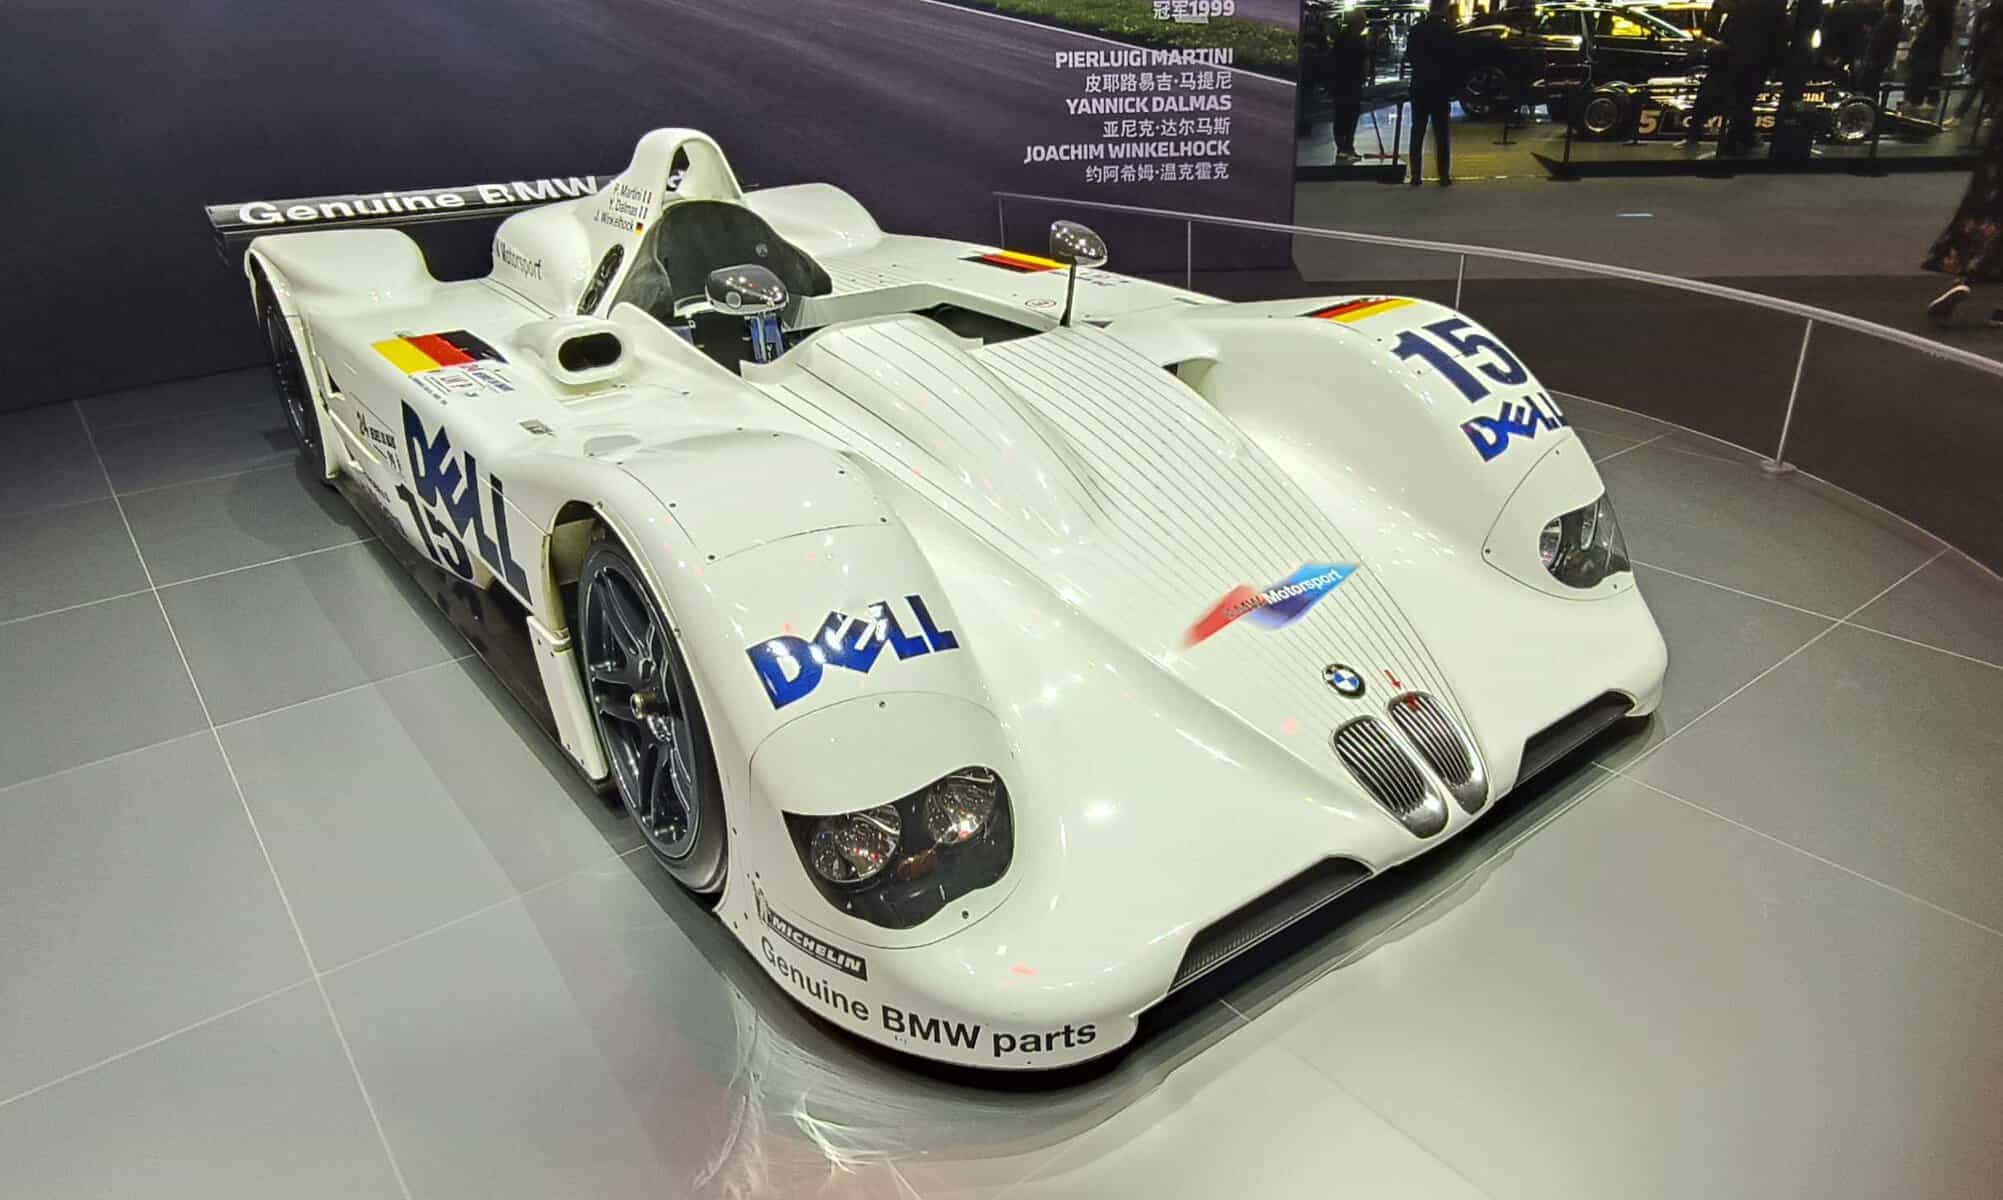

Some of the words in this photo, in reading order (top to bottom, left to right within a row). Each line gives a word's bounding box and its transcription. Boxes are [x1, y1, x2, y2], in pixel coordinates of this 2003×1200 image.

[1153, 0, 1236, 20] 冠军1999
[1055, 49, 1148, 69] PIERLUIGI
[1152, 48, 1233, 66] MARTINI
[1085, 72, 1232, 93] 皮耶路易吉·马提尼
[1066, 96, 1149, 115] YANNICK
[1152, 95, 1232, 114] DALMAS
[1639, 110, 1661, 134] 5
[1103, 117, 1231, 138] 亚尼克·达尔马斯
[1024, 143, 1104, 164] JOACHIM
[1108, 140, 1231, 160] WINKELHOCK
[239, 191, 465, 225] Genuine
[478, 175, 598, 205] BMW
[1391, 318, 1528, 404] 15
[1460, 392, 1569, 463] DELL
[401, 399, 535, 607] DELL
[395, 483, 475, 581] 15
[1263, 568, 1342, 605] Motorsport
[744, 594, 960, 710] DELL
[772, 917, 862, 972] MICHELIN
[761, 935, 870, 1020] Genuine
[882, 1005, 981, 1049] BMW
[993, 1023, 1097, 1057] parts
